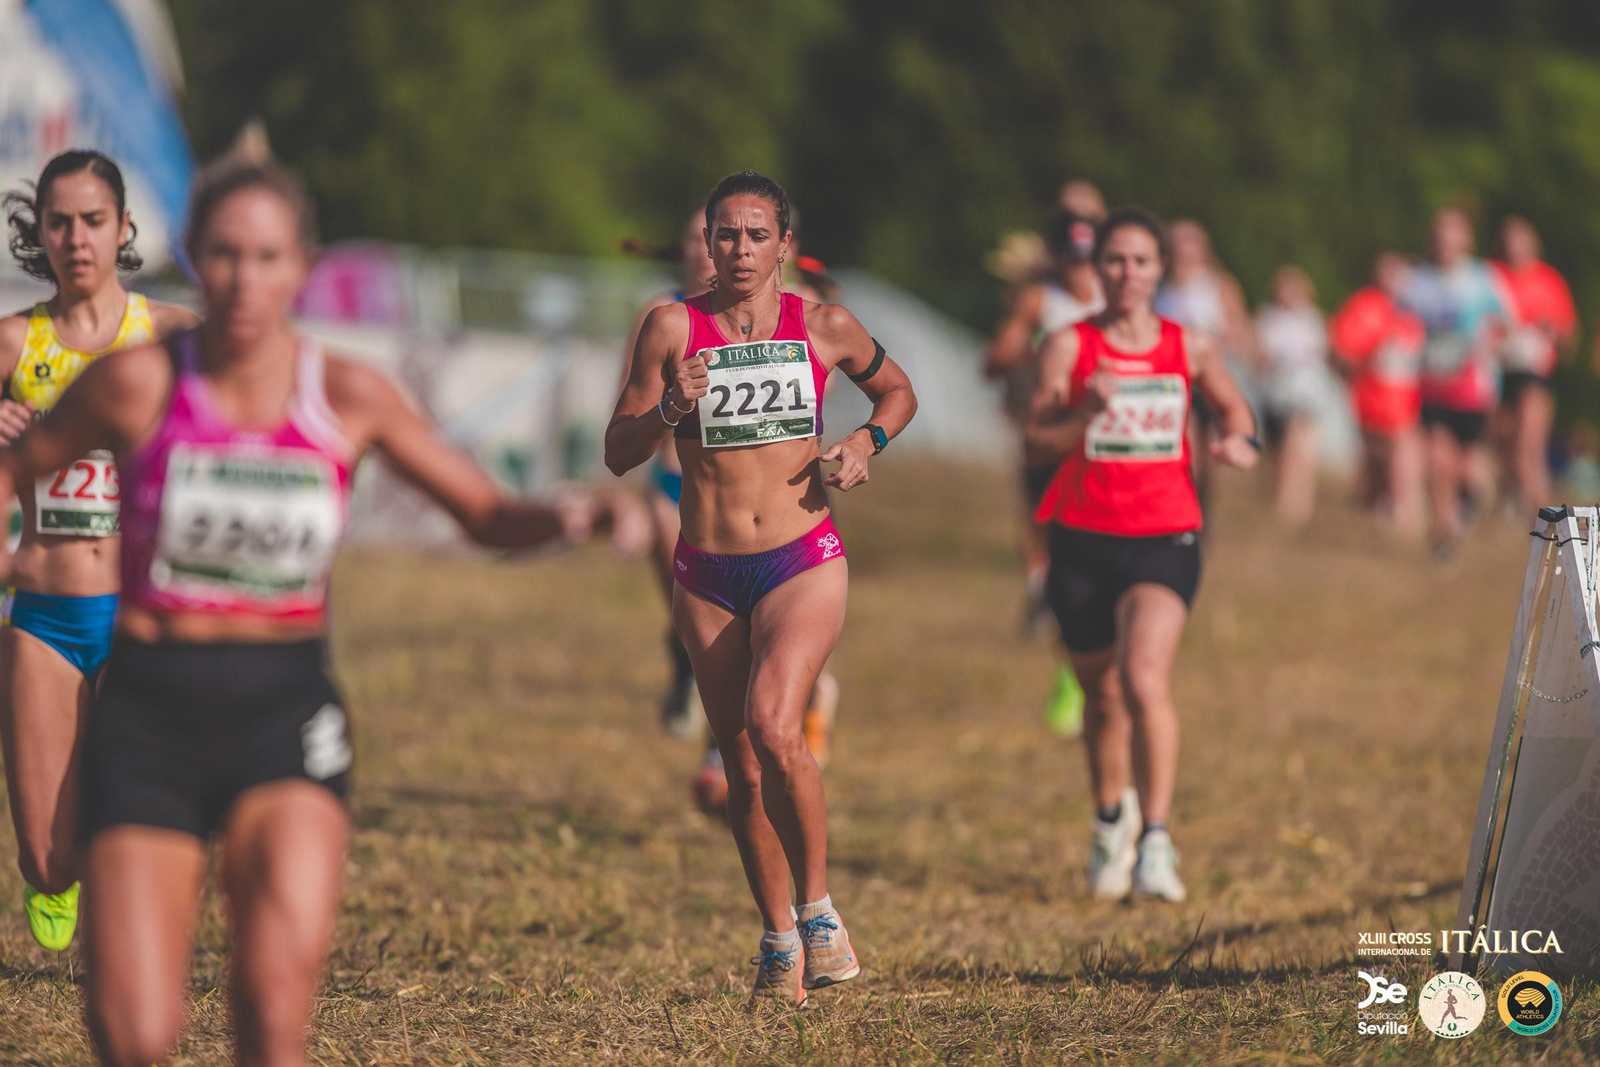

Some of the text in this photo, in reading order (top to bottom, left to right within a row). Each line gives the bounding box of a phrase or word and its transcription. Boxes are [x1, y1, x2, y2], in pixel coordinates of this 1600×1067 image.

[728, 346, 780, 360] ITÁLICA
[710, 378, 807, 418] 2221
[49, 462, 120, 500] 225
